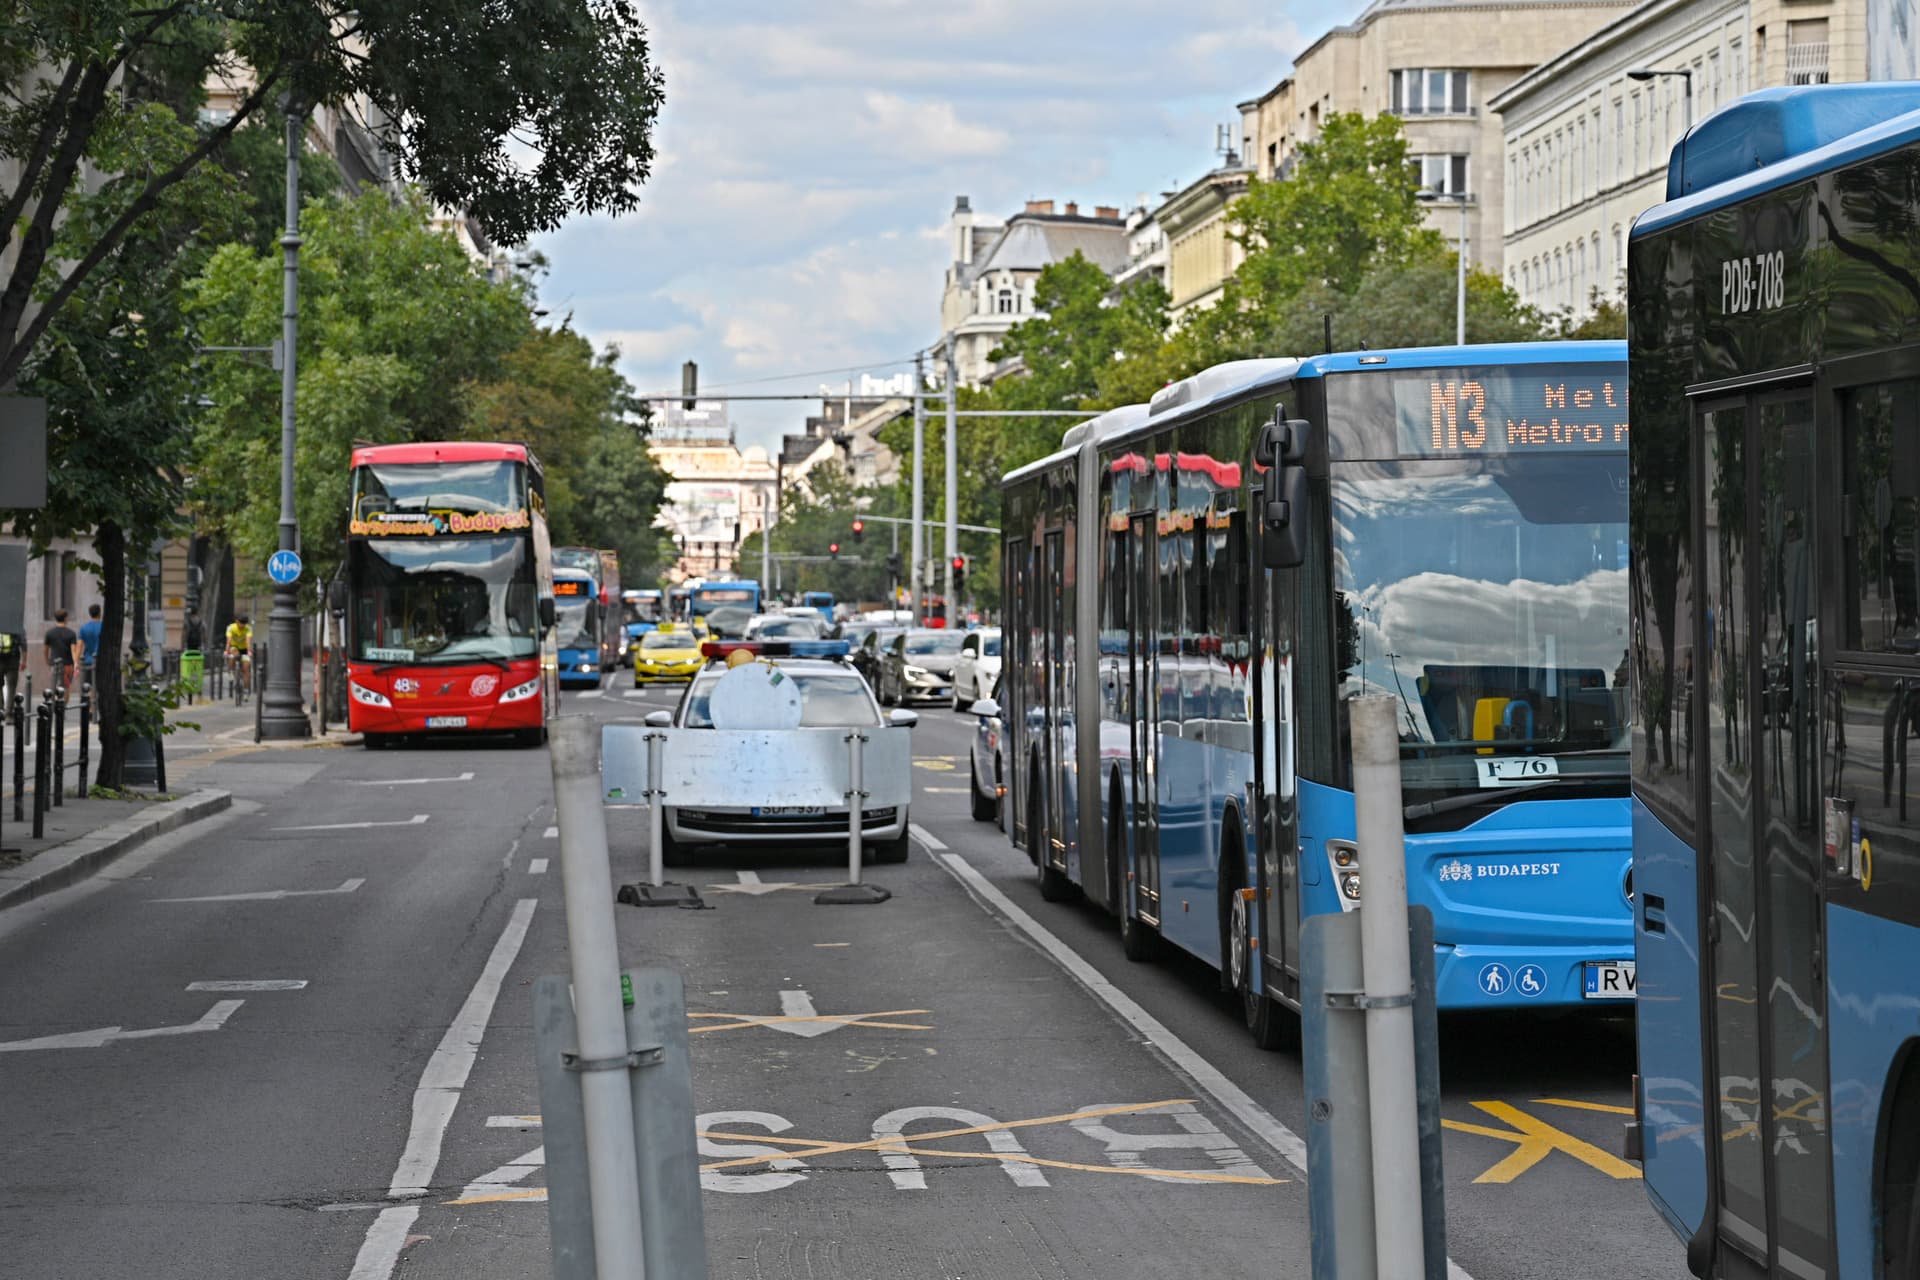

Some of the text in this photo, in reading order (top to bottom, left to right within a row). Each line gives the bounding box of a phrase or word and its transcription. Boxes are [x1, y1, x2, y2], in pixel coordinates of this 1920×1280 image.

[1722, 250, 1784, 315] PDB-708
[1545, 382, 1629, 408] Met
[1430, 381, 1486, 448] M3
[1507, 418, 1603, 444] Metro
[450, 510, 529, 533] Budapest
[1488, 760, 1548, 777] F 76
[1477, 863, 1560, 877] BUDAPEST
[1587, 981, 1595, 990] H
